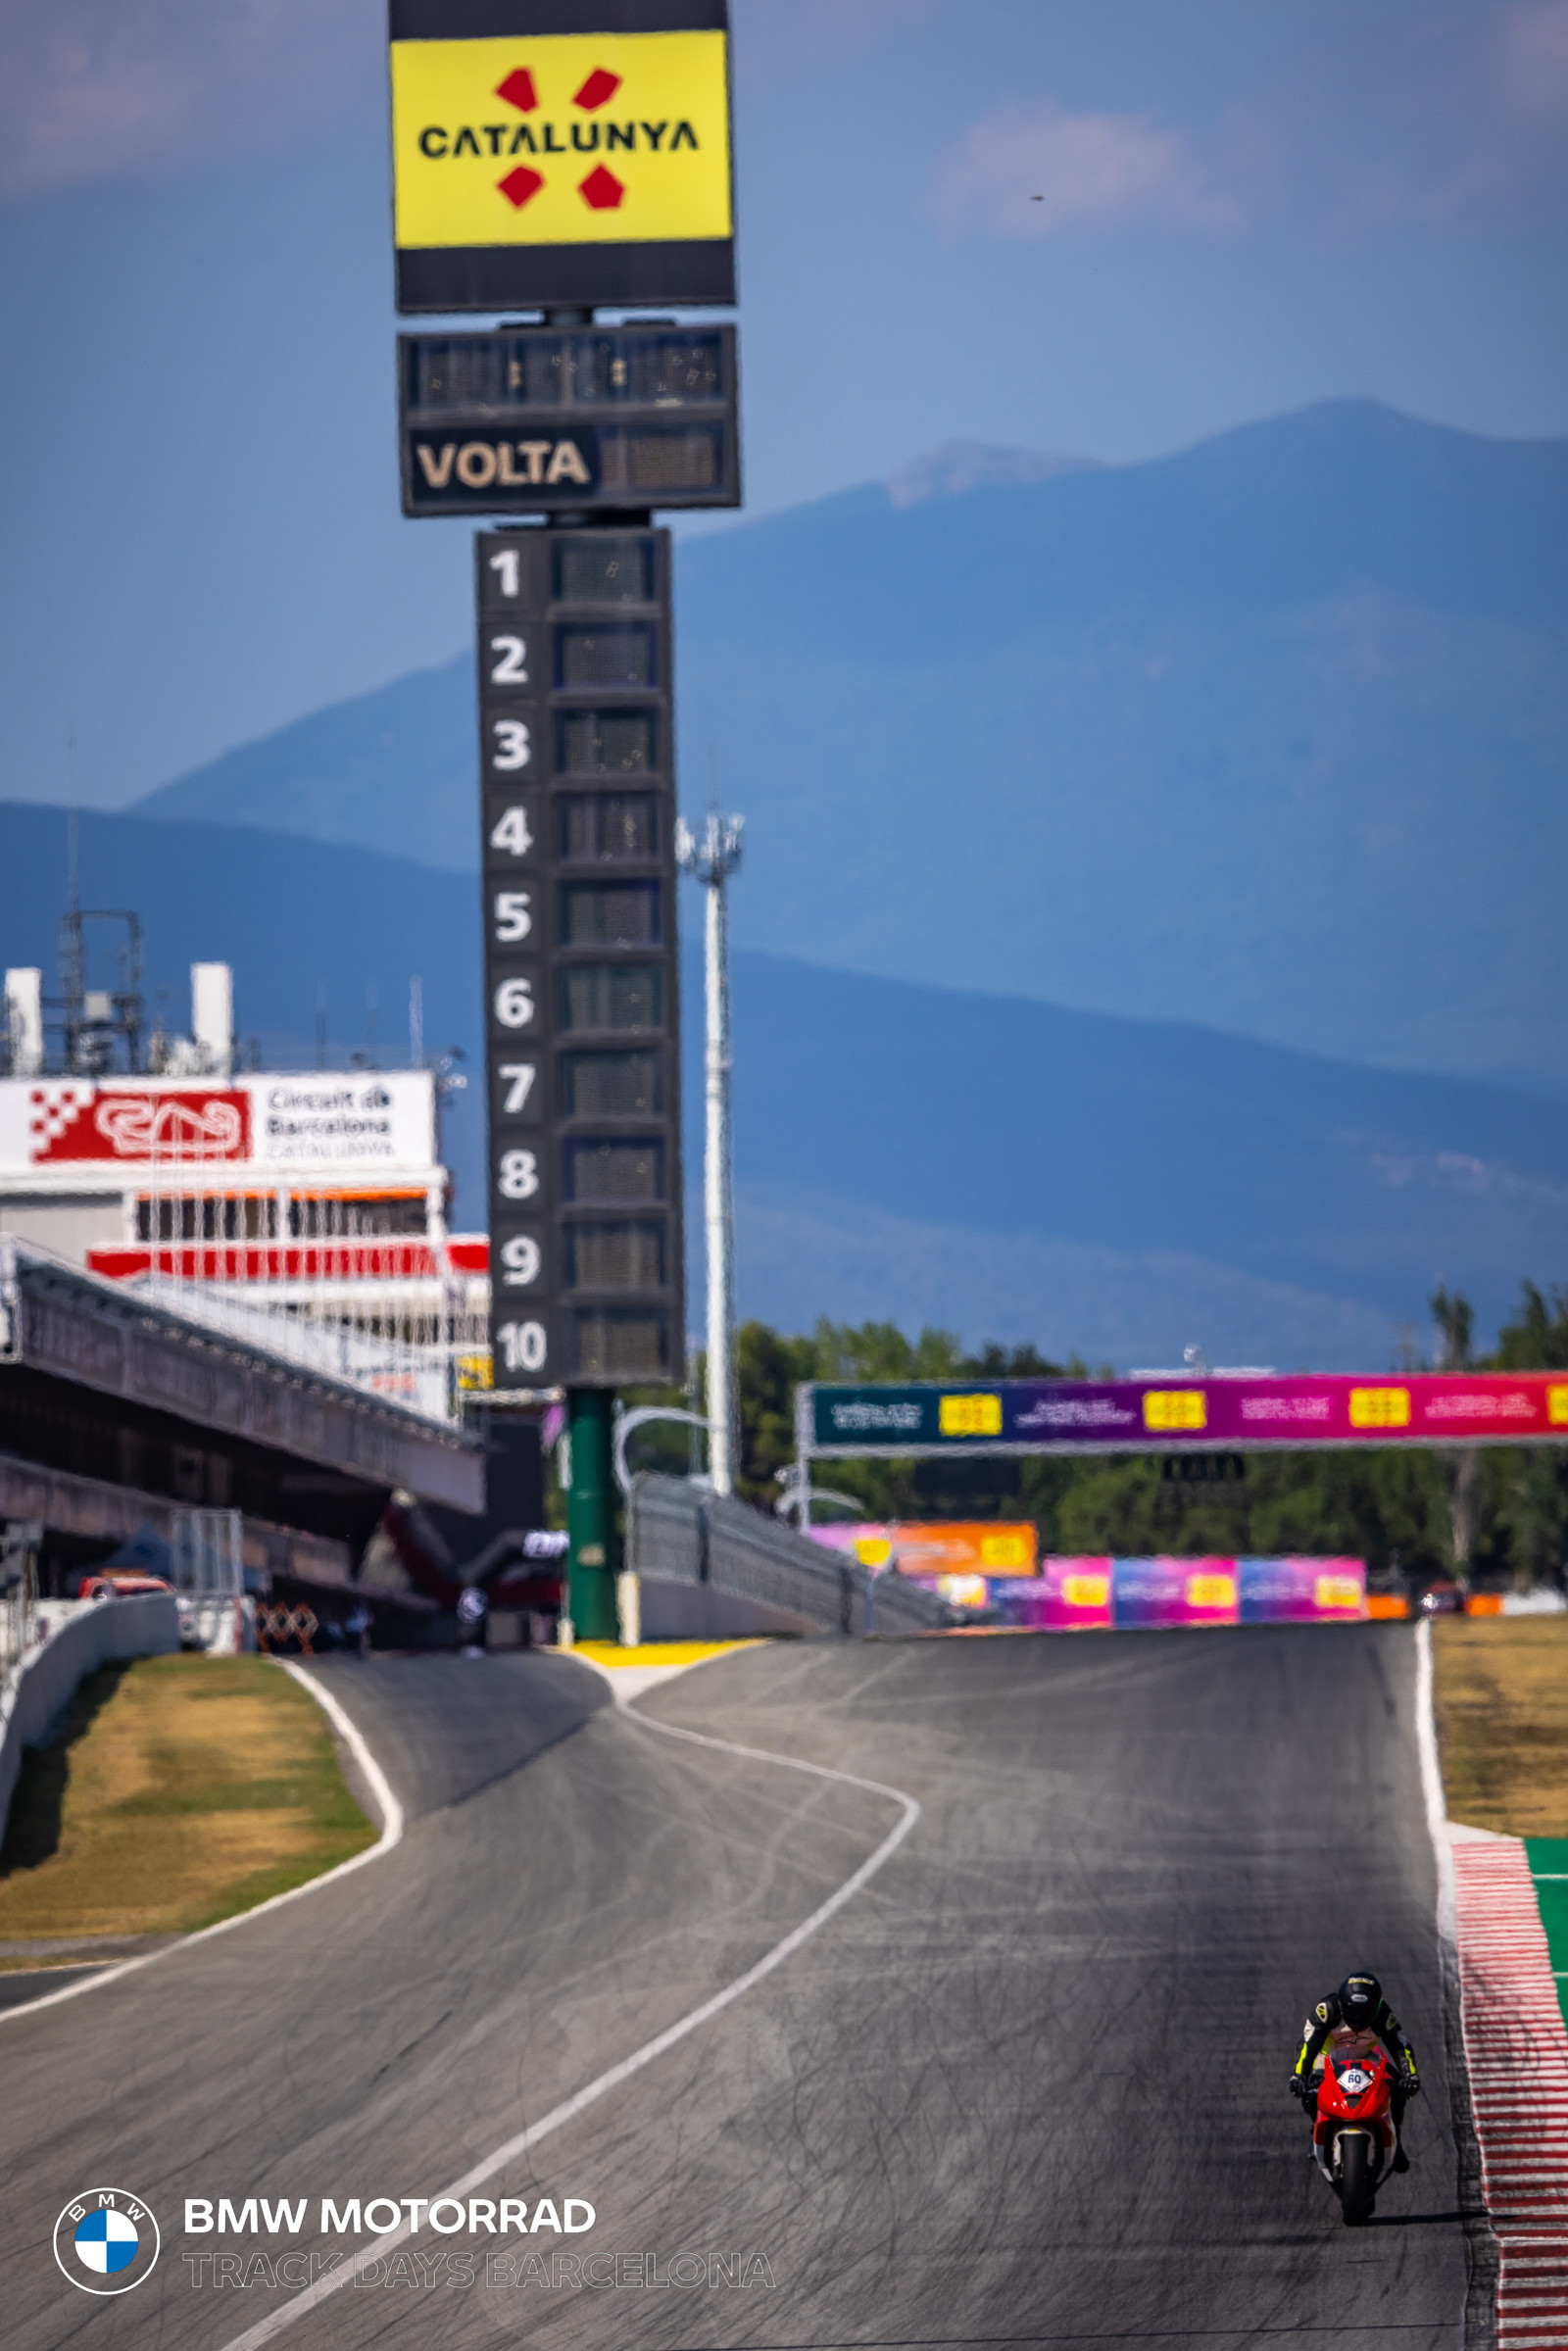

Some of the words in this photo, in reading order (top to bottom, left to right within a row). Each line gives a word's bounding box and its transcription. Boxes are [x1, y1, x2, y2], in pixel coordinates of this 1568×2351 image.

[418, 121, 700, 159] CATALUNYA
[416, 440, 589, 488] VOLTA
[489, 550, 520, 598] 1
[490, 635, 528, 684] 2
[492, 719, 531, 770] 3
[490, 806, 533, 857] 4
[494, 892, 532, 942] 5
[494, 977, 535, 1028] 6
[498, 1062, 536, 1113] 7
[498, 1149, 539, 1200] 8
[500, 1235, 542, 1286] 9
[497, 1320, 547, 1372] 10
[1348, 2074, 1361, 2084] 60
